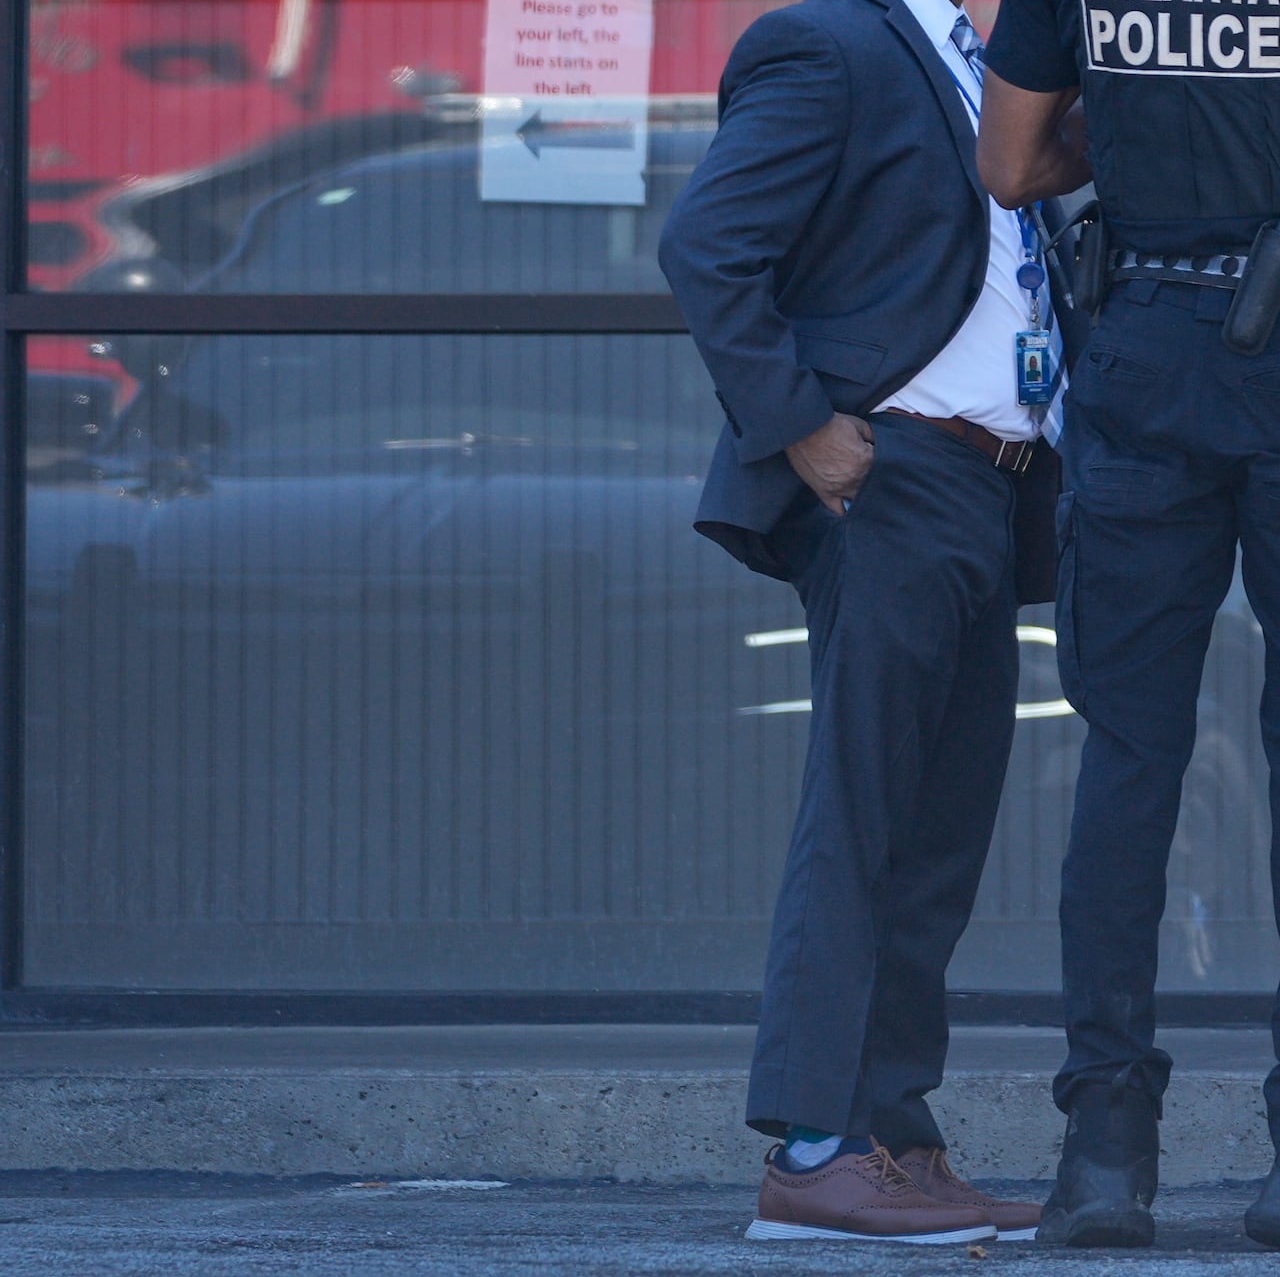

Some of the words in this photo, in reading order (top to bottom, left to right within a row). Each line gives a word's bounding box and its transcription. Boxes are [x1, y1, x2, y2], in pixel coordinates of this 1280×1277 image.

[522, 0, 572, 15] Please
[577, 3, 597, 18] go
[601, 3, 618, 15] to
[516, 29, 552, 43] your
[557, 28, 589, 44] left,
[593, 29, 620, 43] the
[514, 54, 545, 68] line
[550, 55, 593, 70] starts
[598, 59, 619, 70] on
[534, 82, 560, 95] the
